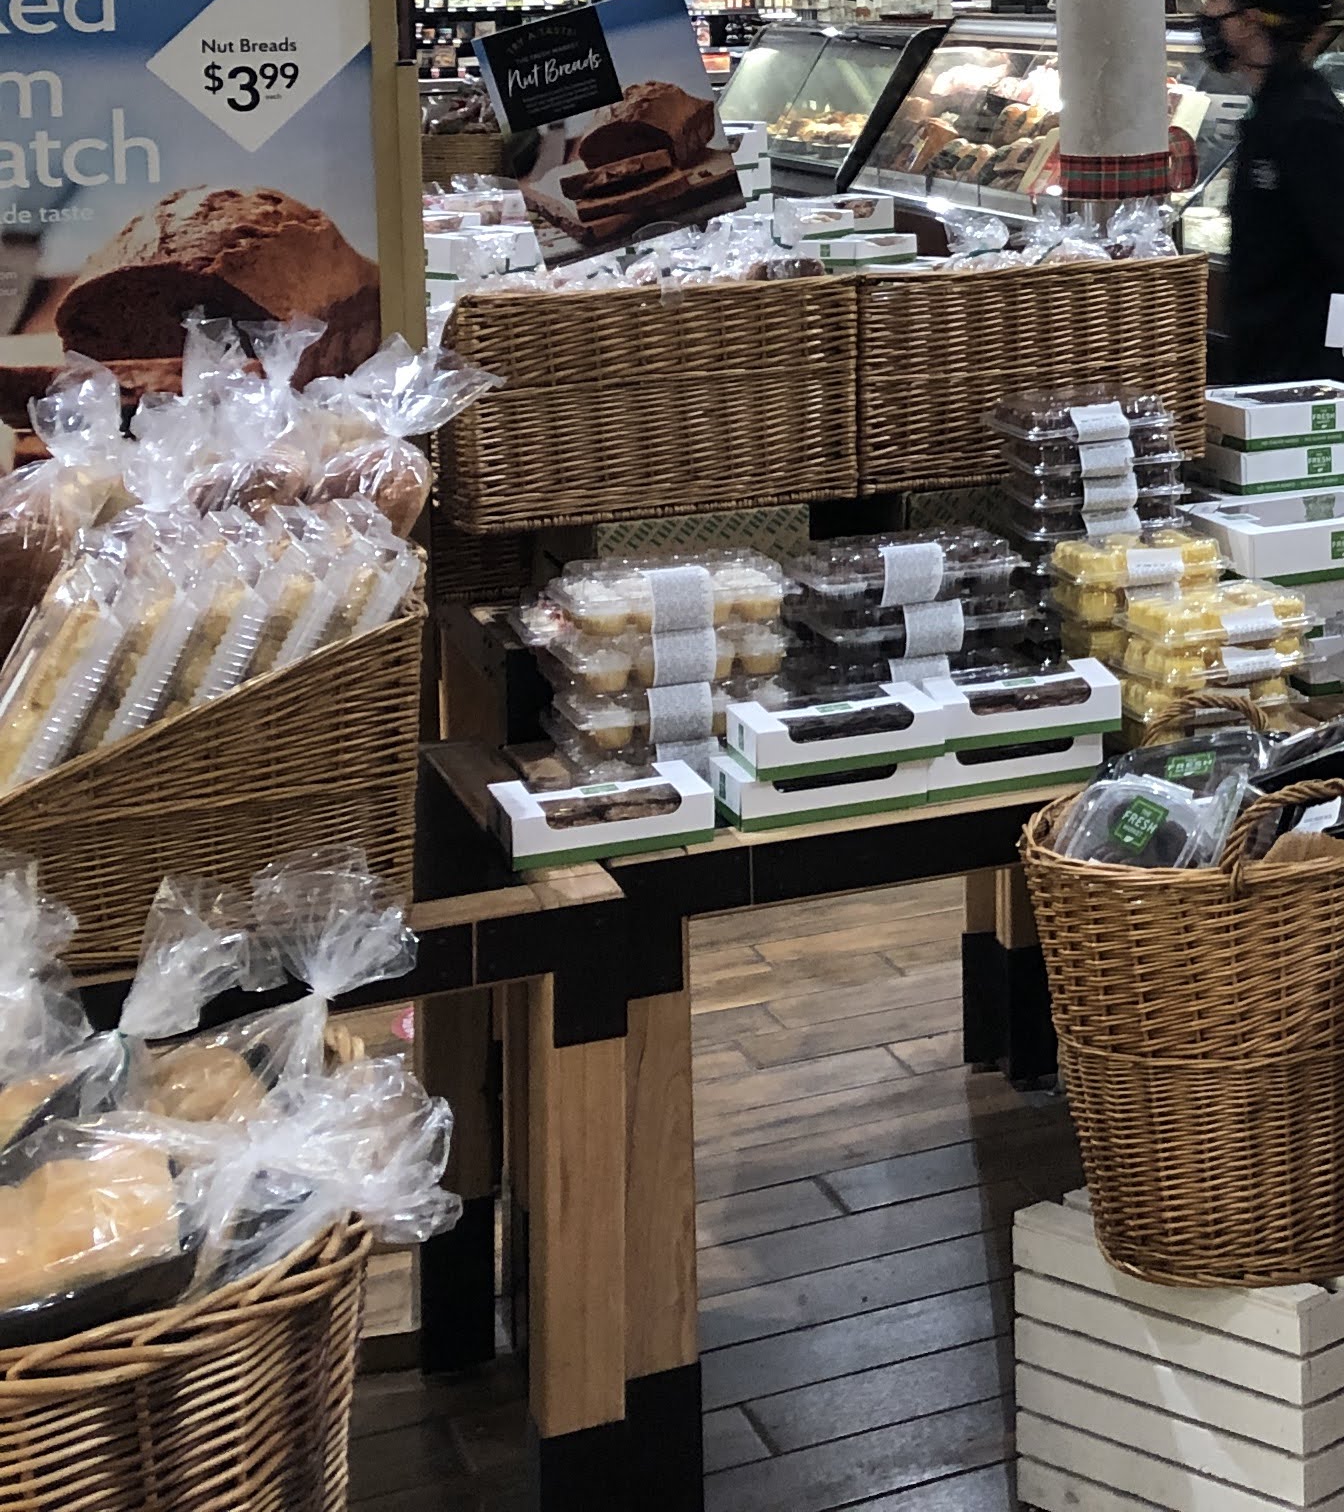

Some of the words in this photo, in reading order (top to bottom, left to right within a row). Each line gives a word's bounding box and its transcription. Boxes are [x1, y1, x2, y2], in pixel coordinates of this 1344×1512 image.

[202, 39, 234, 54] Nut
[240, 36, 297, 53] Breads
[508, 64, 543, 98] Nut
[544, 48, 603, 85] Breads
[0, 203, 32, 225] de
[39, 206, 95, 224] taste
[1121, 810, 1159, 835] FRESH
